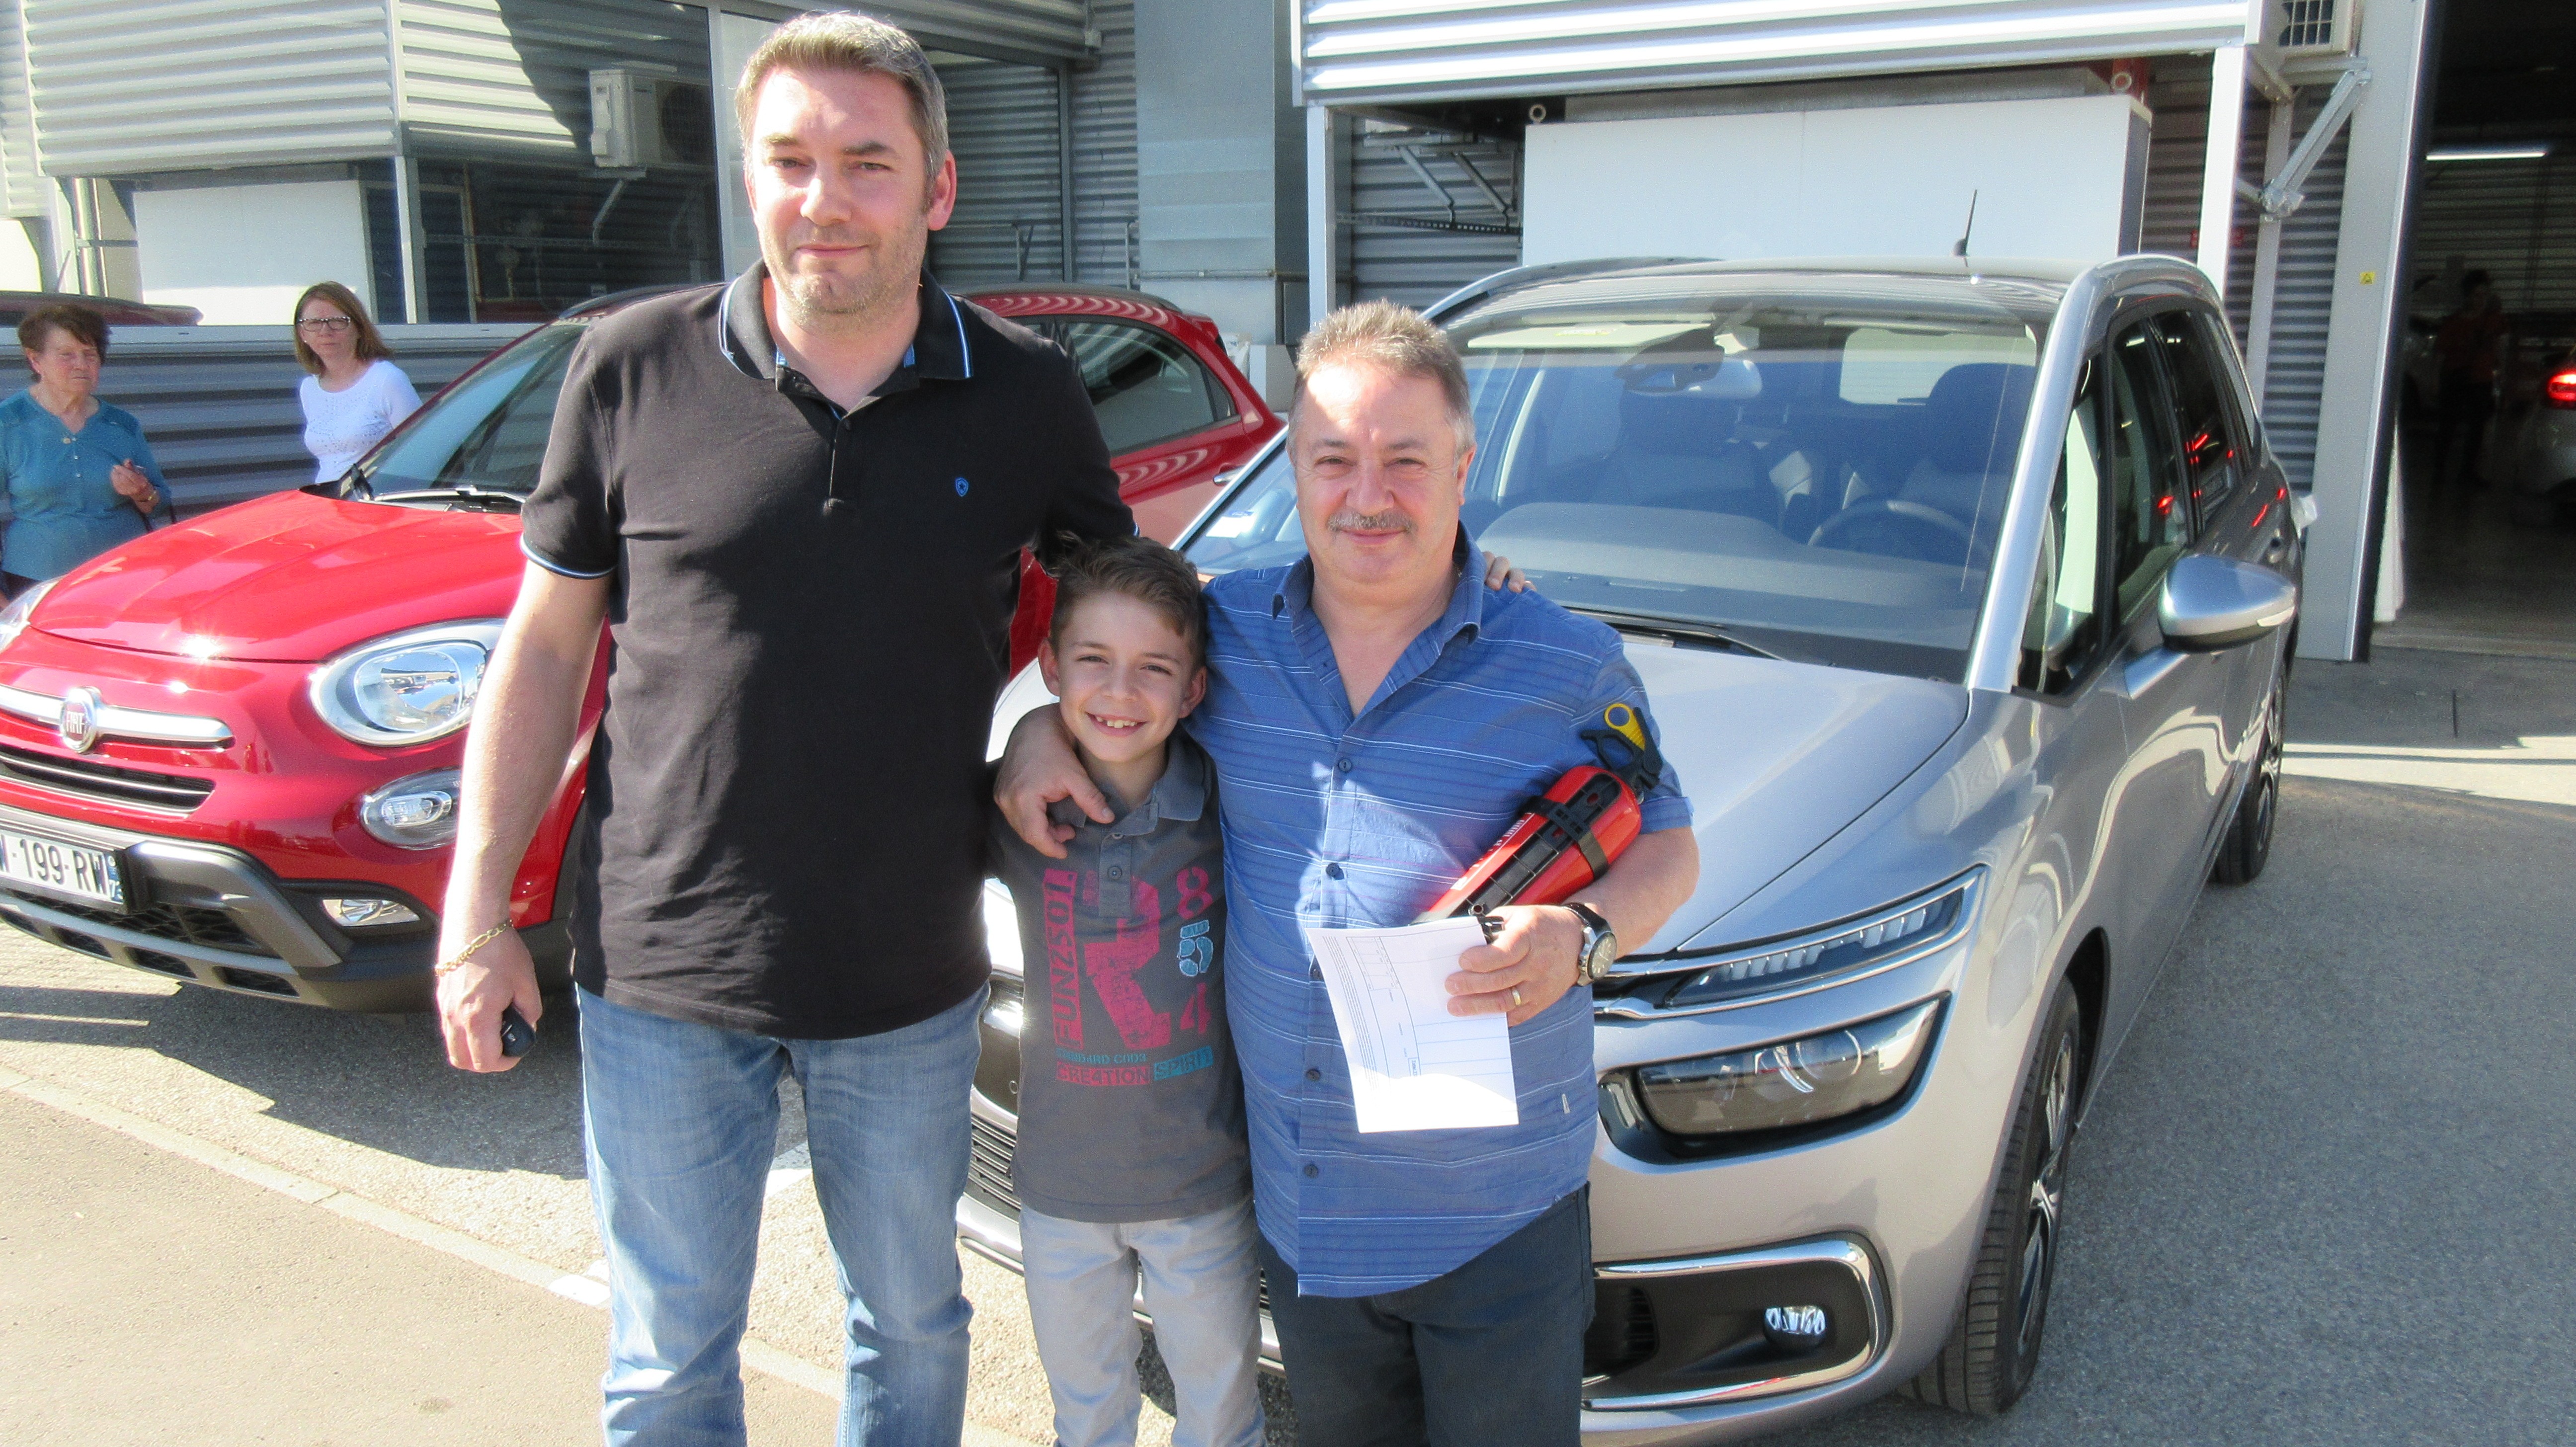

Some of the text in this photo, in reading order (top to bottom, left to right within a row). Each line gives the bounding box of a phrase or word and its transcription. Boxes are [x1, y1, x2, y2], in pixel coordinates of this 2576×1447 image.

[66, 711, 85, 734] FIAT
[1177, 867, 1213, 920] 8
[1177, 920, 1213, 977] 5
[1180, 982, 1211, 1034] 4
[1156, 1048, 1211, 1079] SPIRIT
